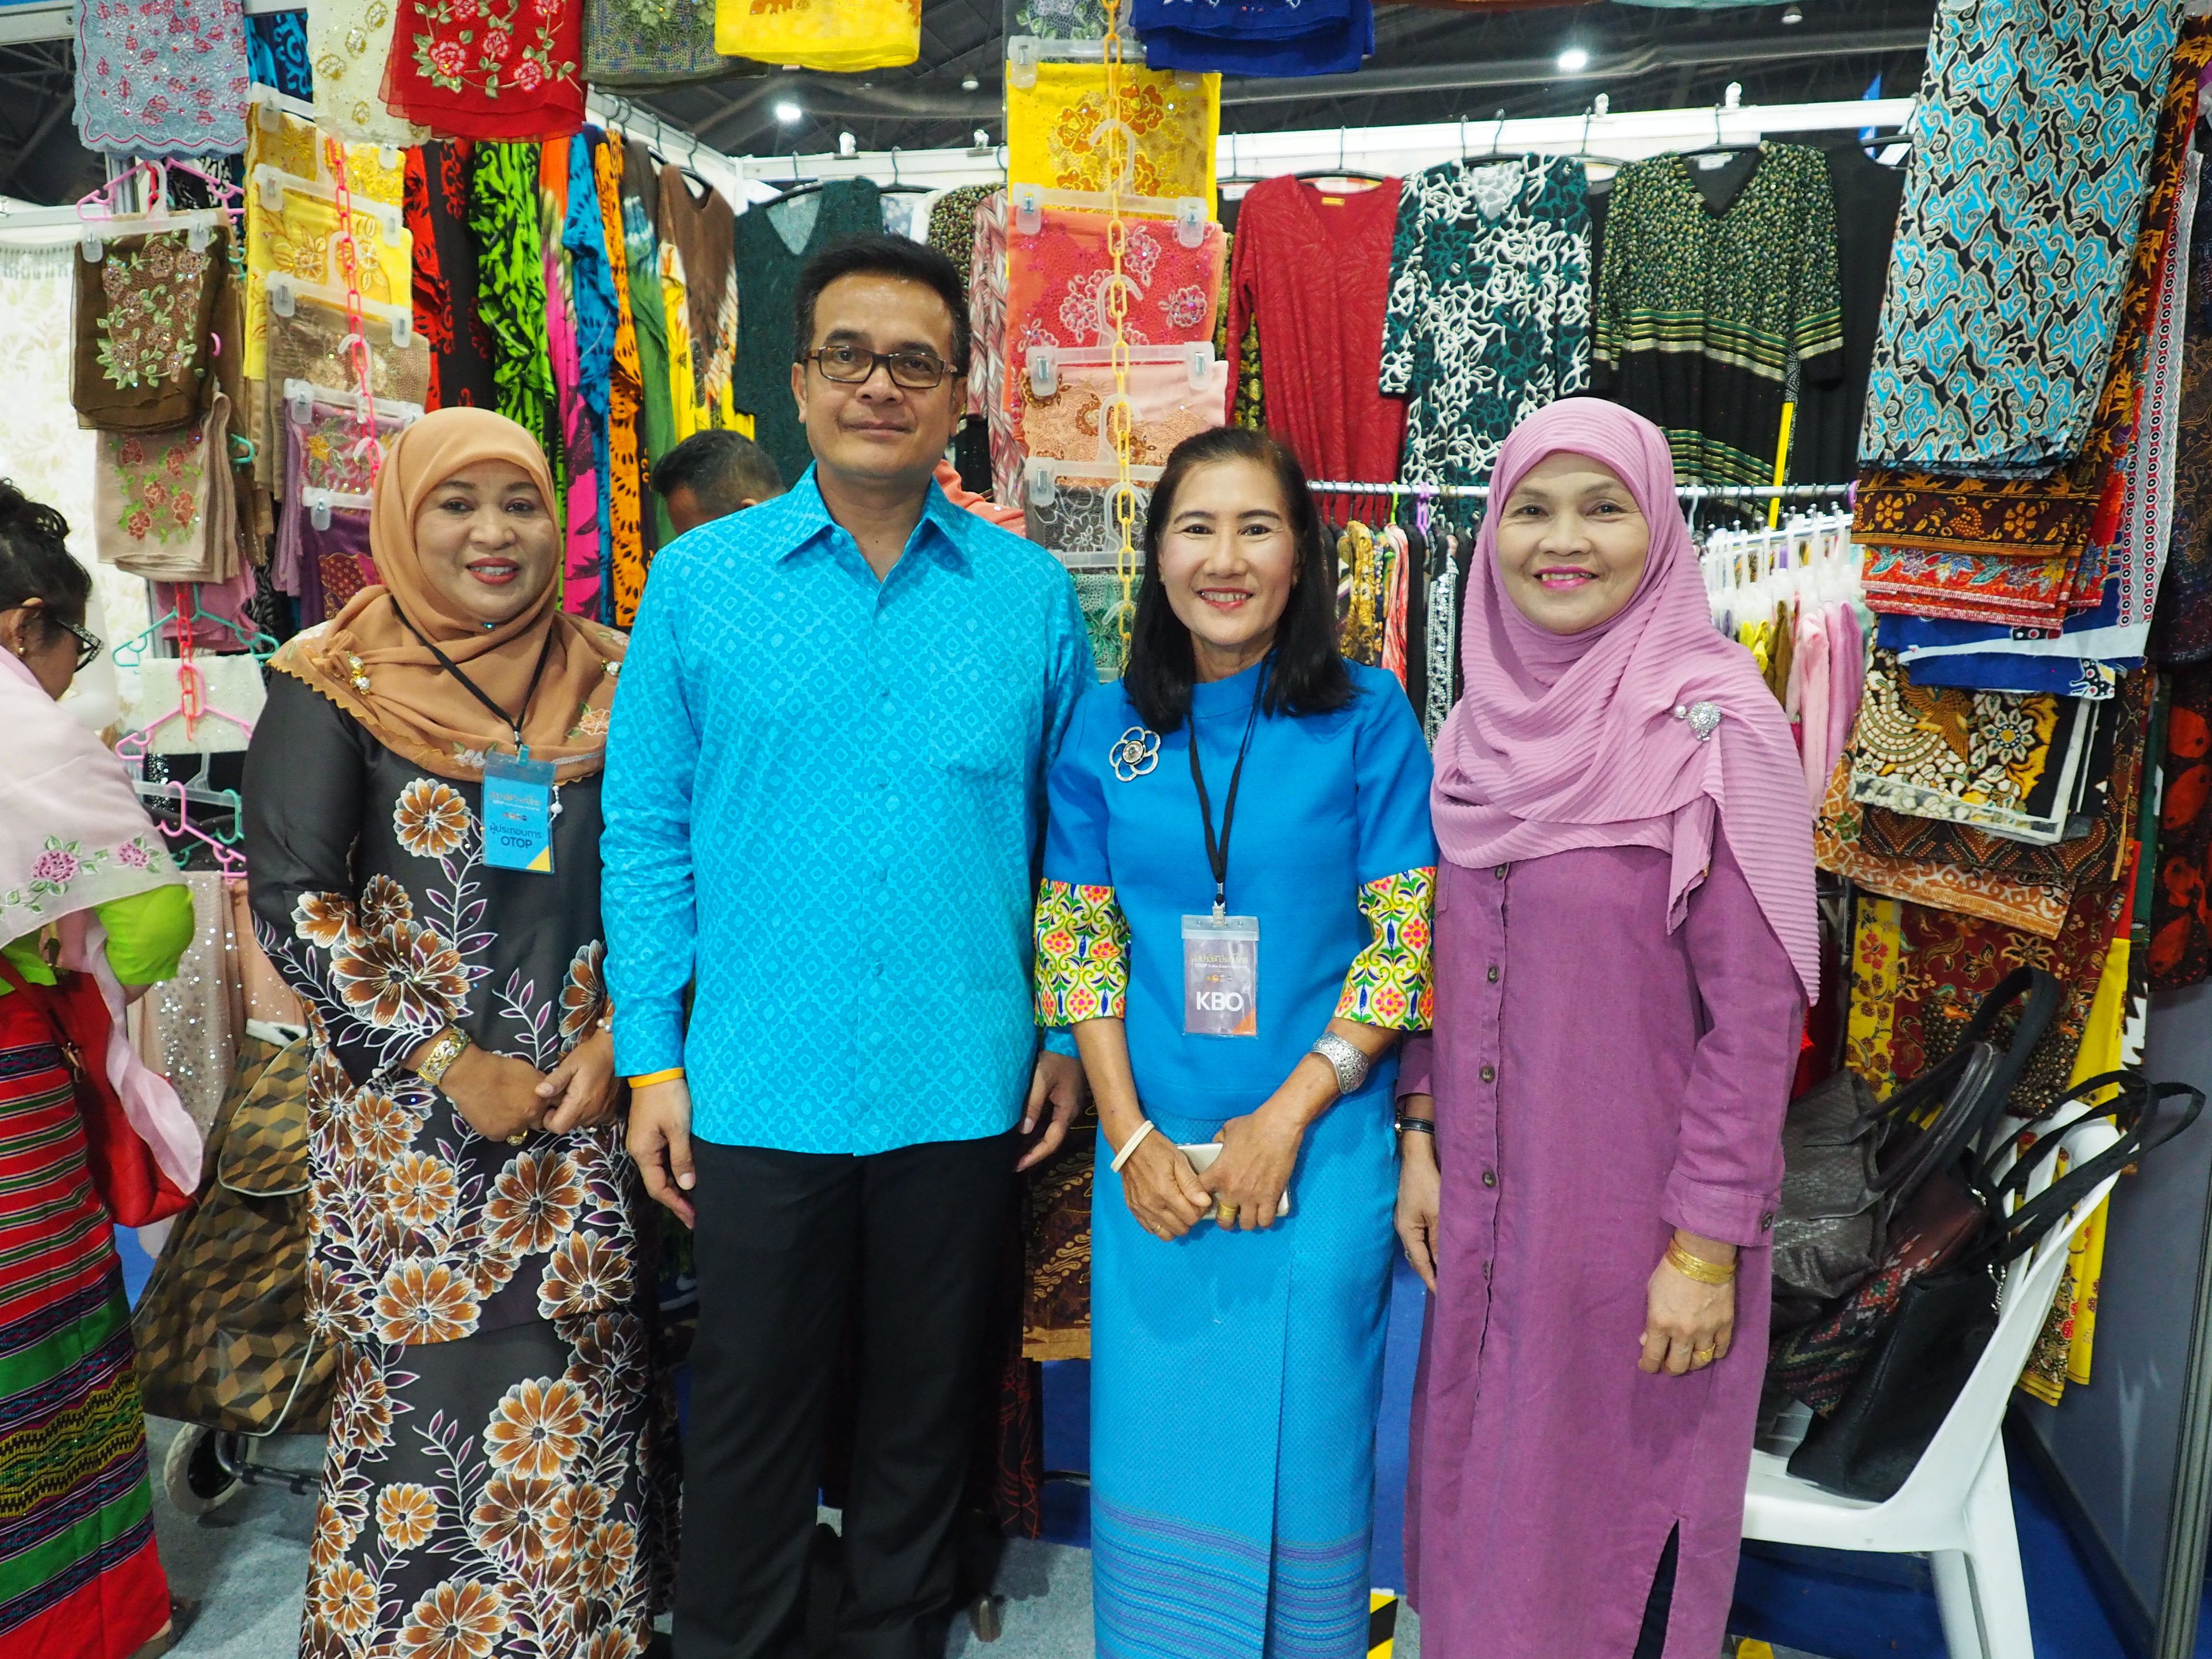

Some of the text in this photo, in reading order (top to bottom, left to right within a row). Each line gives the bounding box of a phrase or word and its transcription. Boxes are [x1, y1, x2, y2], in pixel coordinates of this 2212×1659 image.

[490, 822, 542, 838] ผู้ประกอบการ
[501, 836, 532, 849] OTOP
[1197, 991, 1243, 1011] KBO
